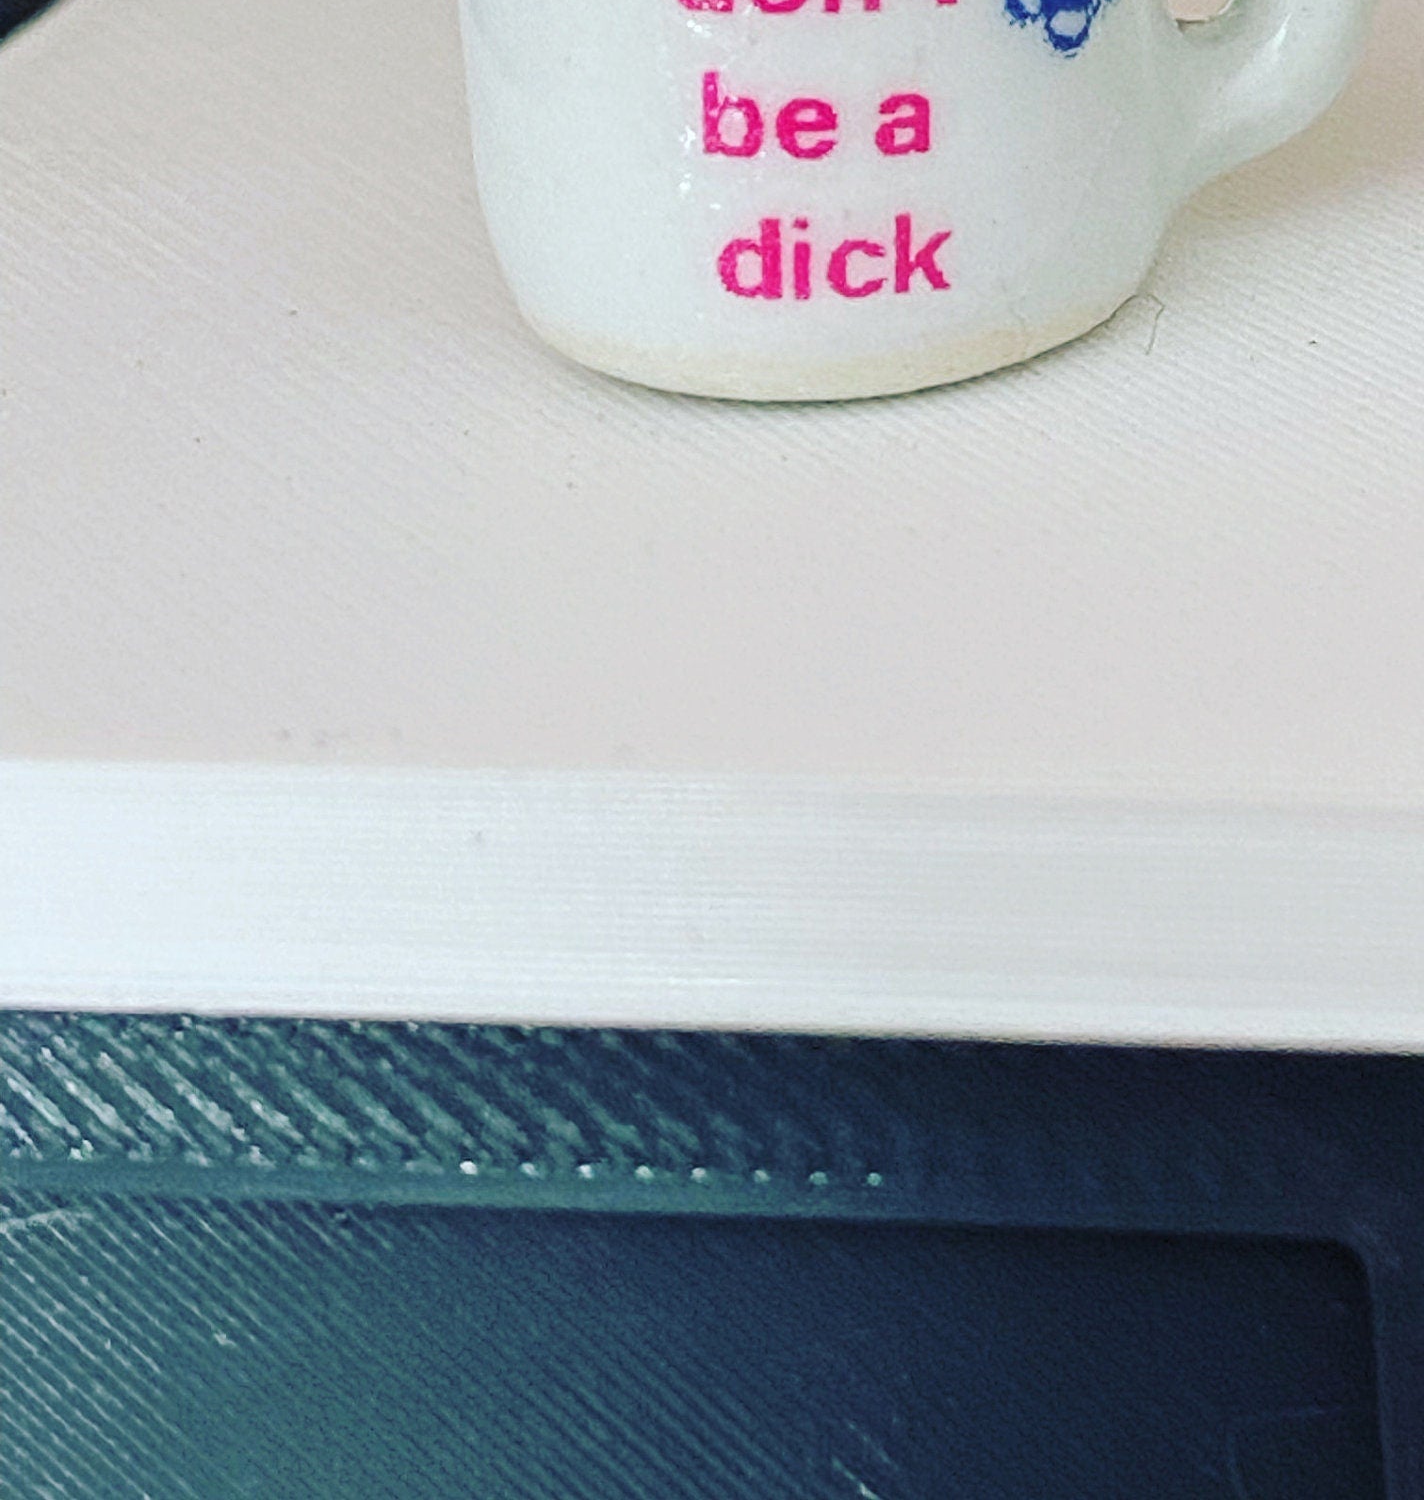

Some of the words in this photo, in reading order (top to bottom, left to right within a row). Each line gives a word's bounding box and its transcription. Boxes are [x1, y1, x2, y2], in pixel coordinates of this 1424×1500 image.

[701, 69, 840, 160] be
[873, 91, 932, 157] a
[716, 211, 953, 300] dick
